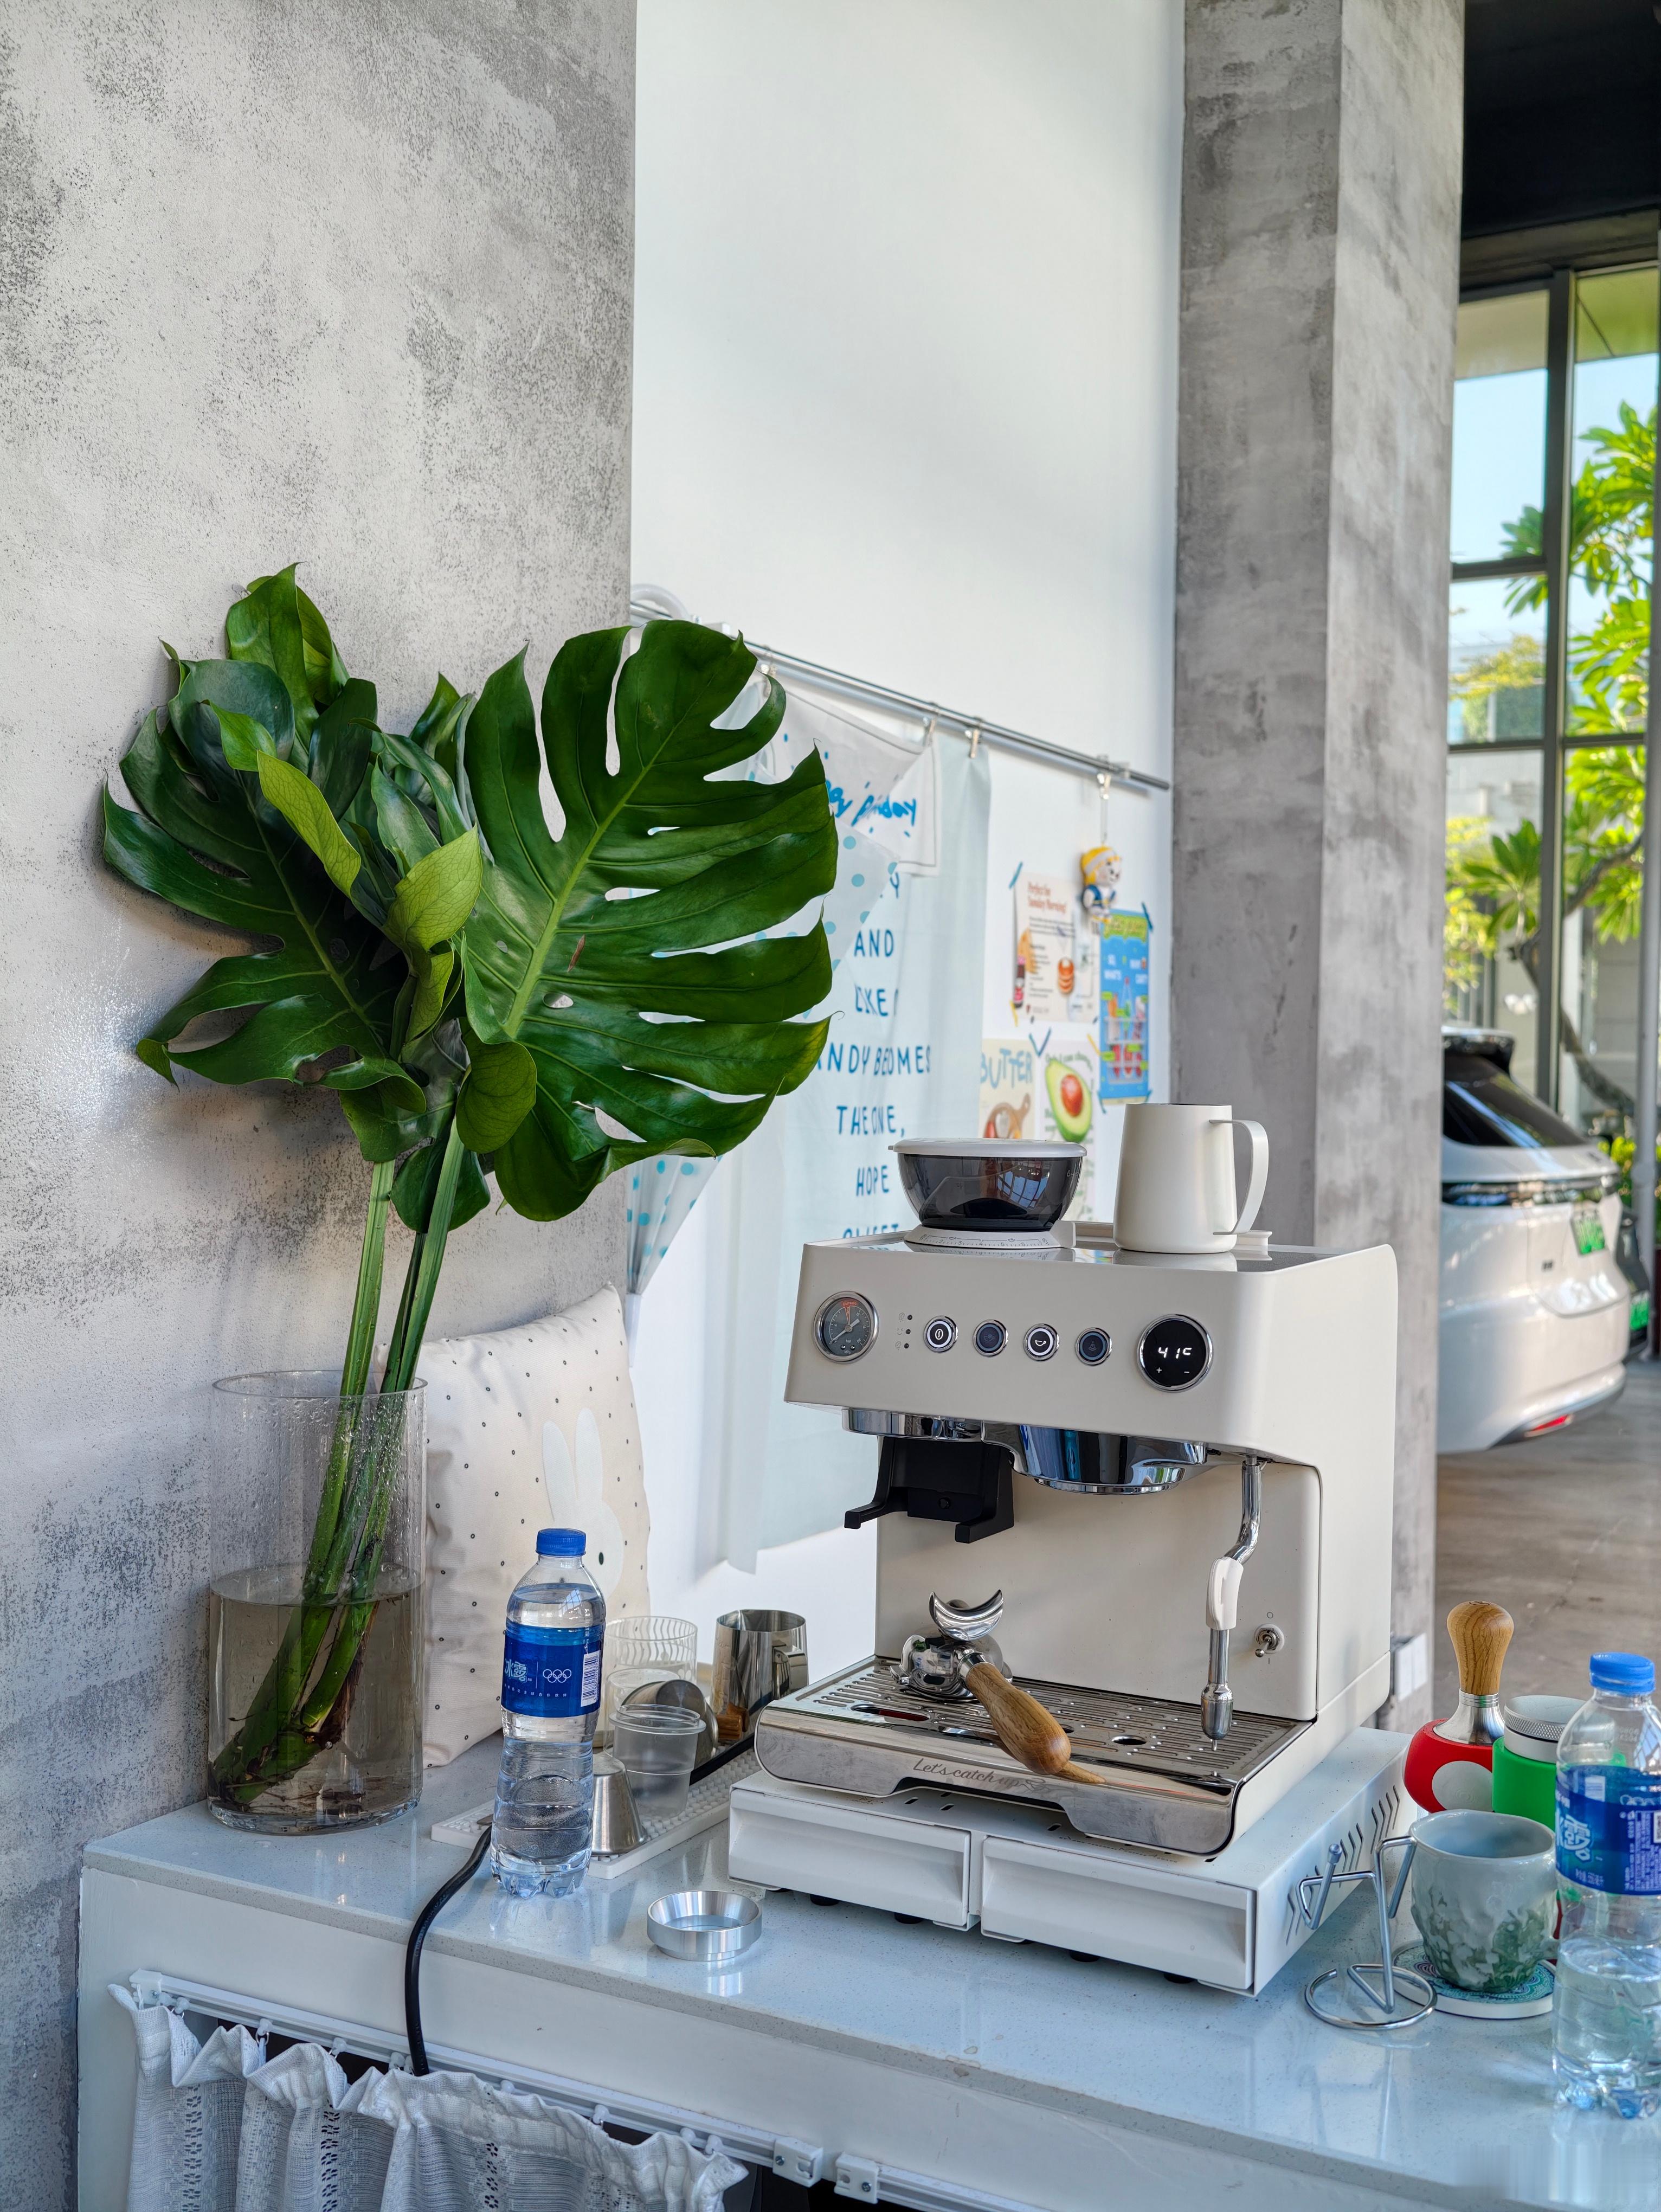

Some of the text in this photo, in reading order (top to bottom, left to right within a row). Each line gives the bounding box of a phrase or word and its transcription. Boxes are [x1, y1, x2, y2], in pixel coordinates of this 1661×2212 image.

[854, 929, 894, 957] AND
[836, 1105, 868, 1135] THE
[856, 1165, 890, 1196] HOPE
[913, 1758, 948, 1775] Let's
[952, 1769, 997, 1783] catch
